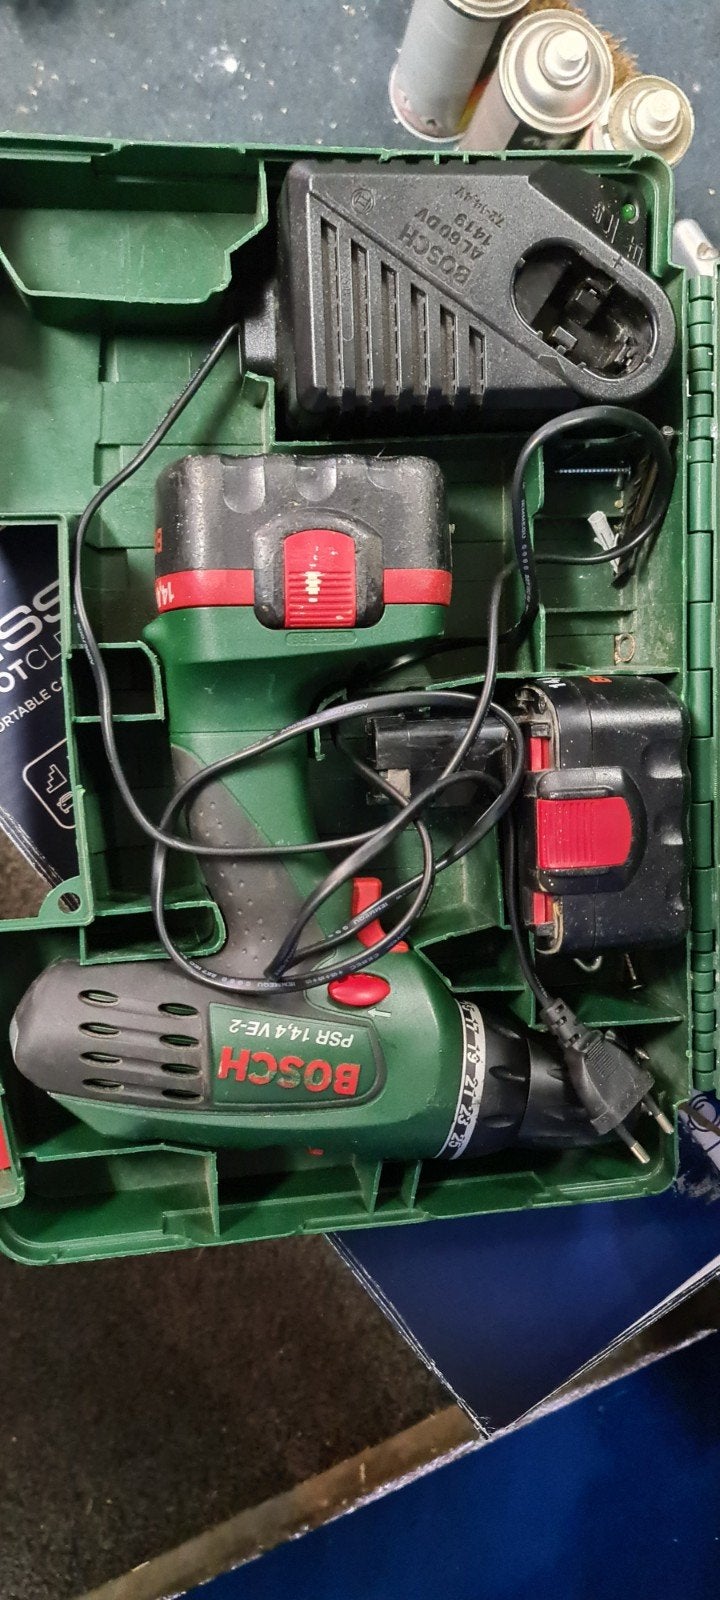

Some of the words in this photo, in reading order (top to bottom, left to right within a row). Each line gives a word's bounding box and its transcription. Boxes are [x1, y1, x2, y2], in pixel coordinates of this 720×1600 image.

[454, 213, 492, 246] 1419
[398, 222, 471, 284] BOSCH
[228, 1018, 270, 1038] VE-2
[274, 1022, 310, 1042] 14,4
[465, 1016, 479, 1035] 17
[315, 1029, 354, 1048] PSR
[467, 1043, 481, 1063] 19
[216, 1045, 361, 1097] BOSCH
[463, 1074, 478, 1098] 21
[457, 1103, 473, 1126] 23
[449, 1132, 465, 1148] 25
